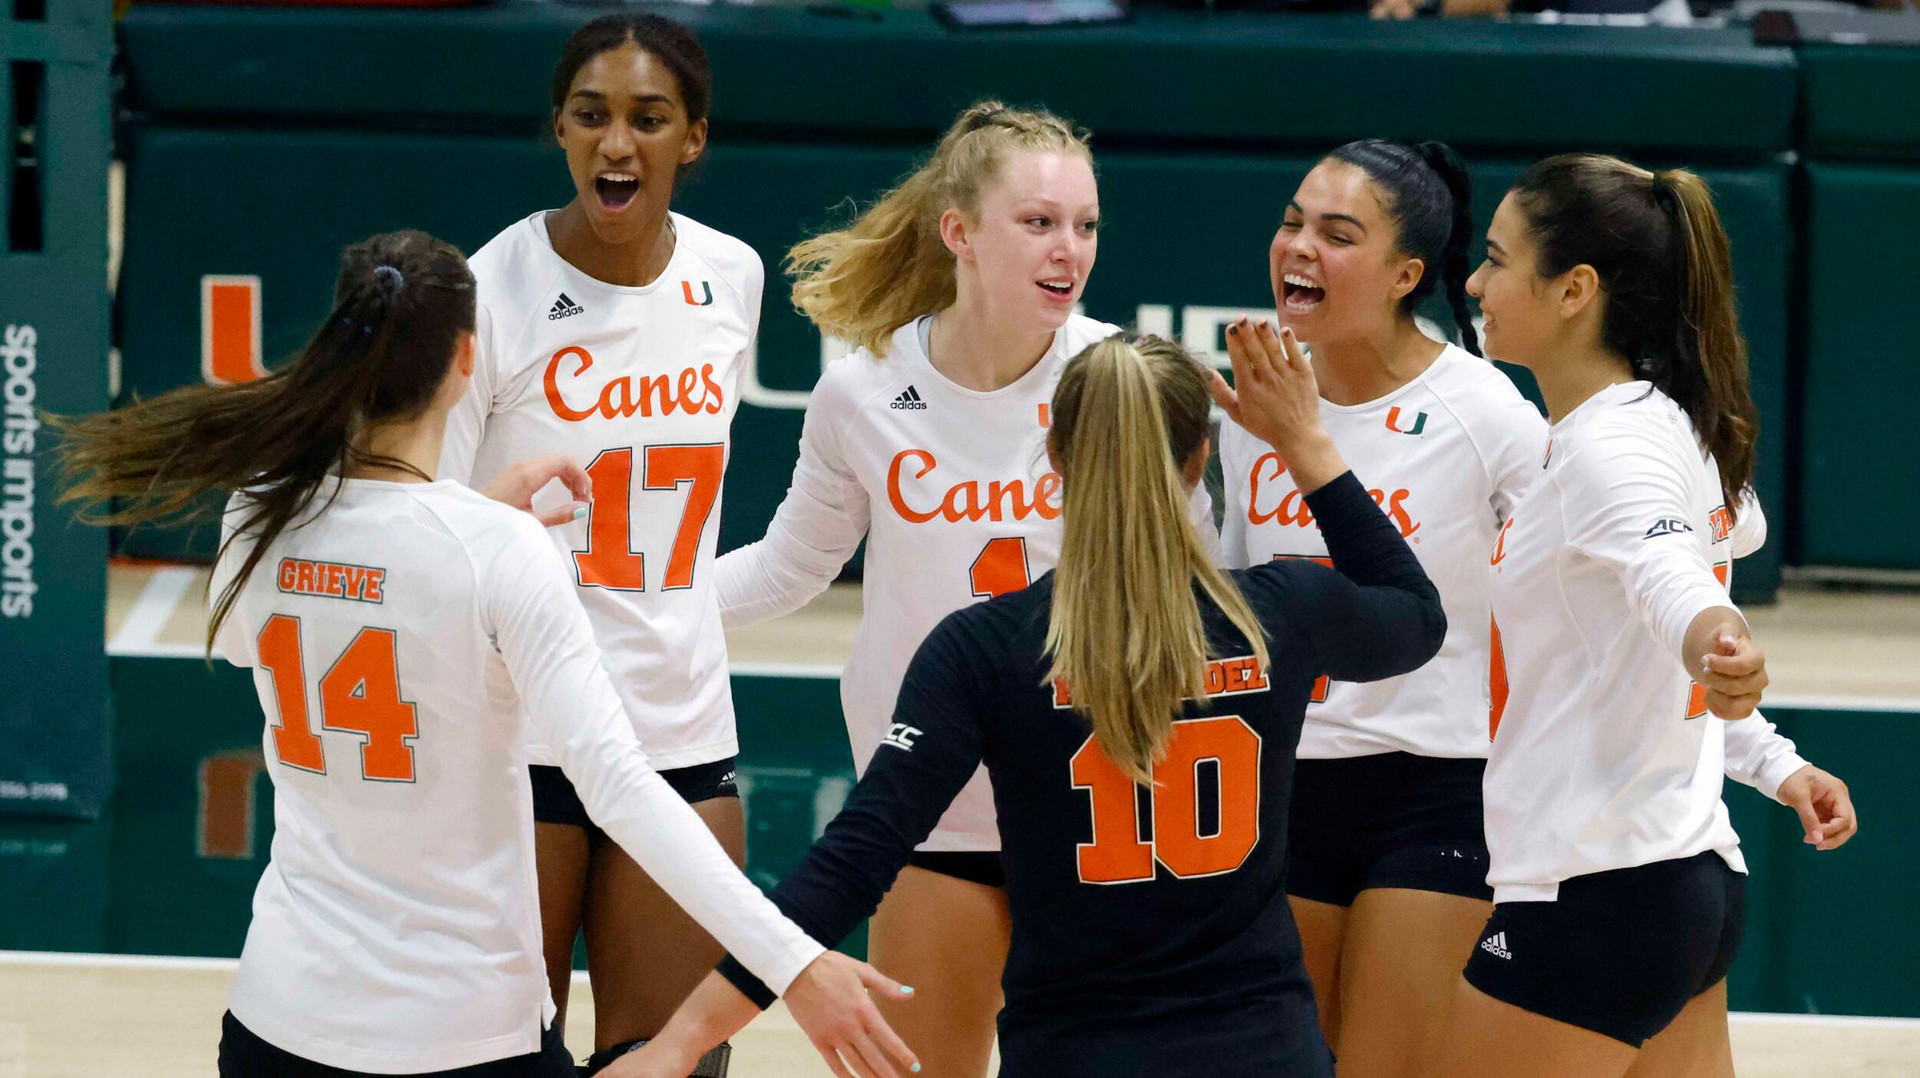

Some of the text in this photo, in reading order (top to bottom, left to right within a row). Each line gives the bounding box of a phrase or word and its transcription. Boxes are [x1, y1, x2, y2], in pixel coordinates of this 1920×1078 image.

[548, 304, 585, 321] adidas
[680, 280, 713, 306] U
[543, 345, 724, 422] Canes
[890, 400, 928, 410] adidas
[1385, 406, 1428, 435] U
[0, 324, 40, 618] sports imports
[887, 449, 1064, 523] Cane
[1247, 451, 1421, 538] Cas
[572, 442, 725, 592] 17
[276, 557, 387, 604] GRIEVE
[256, 613, 420, 783] 14
[885, 722, 924, 747] CC
[1069, 714, 1262, 886] 10
[1481, 941, 1513, 960] adidas
